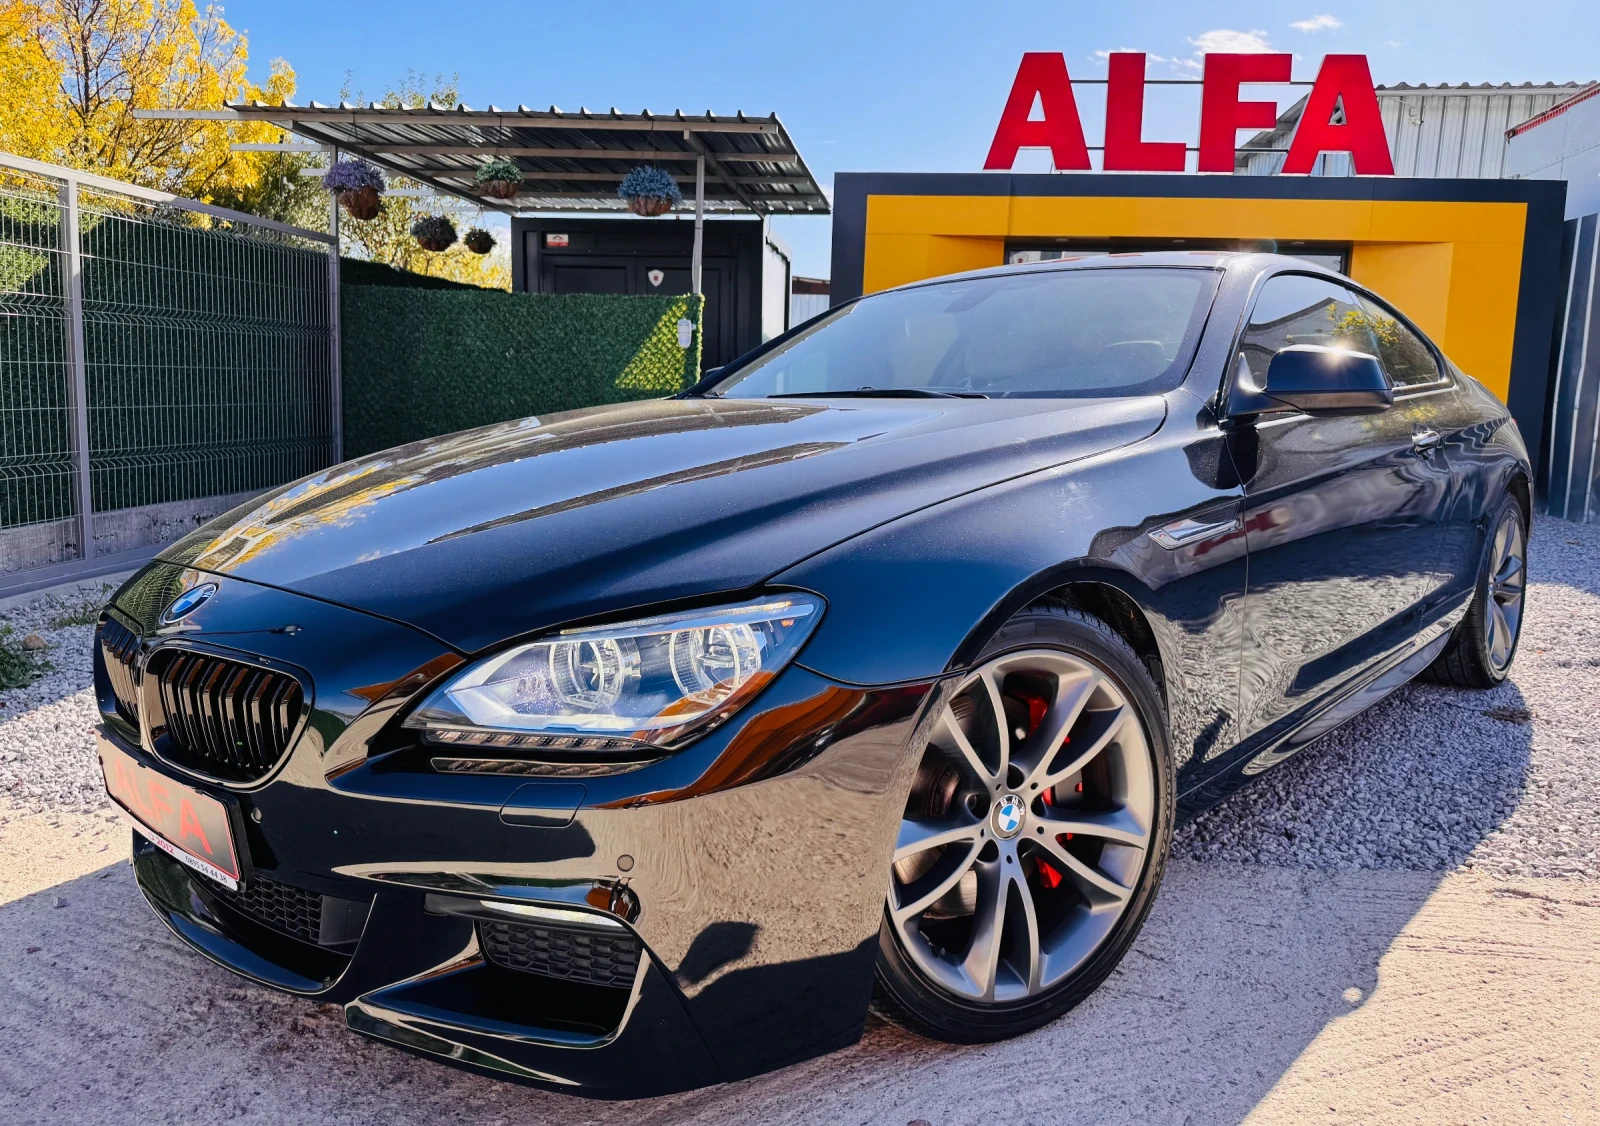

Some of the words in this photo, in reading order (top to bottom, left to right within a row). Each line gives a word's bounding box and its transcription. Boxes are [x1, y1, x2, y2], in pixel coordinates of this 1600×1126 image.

[982, 52, 1395, 175] ALFA
[113, 756, 214, 856] ALFA
[1000, 796, 1025, 816] BMW
